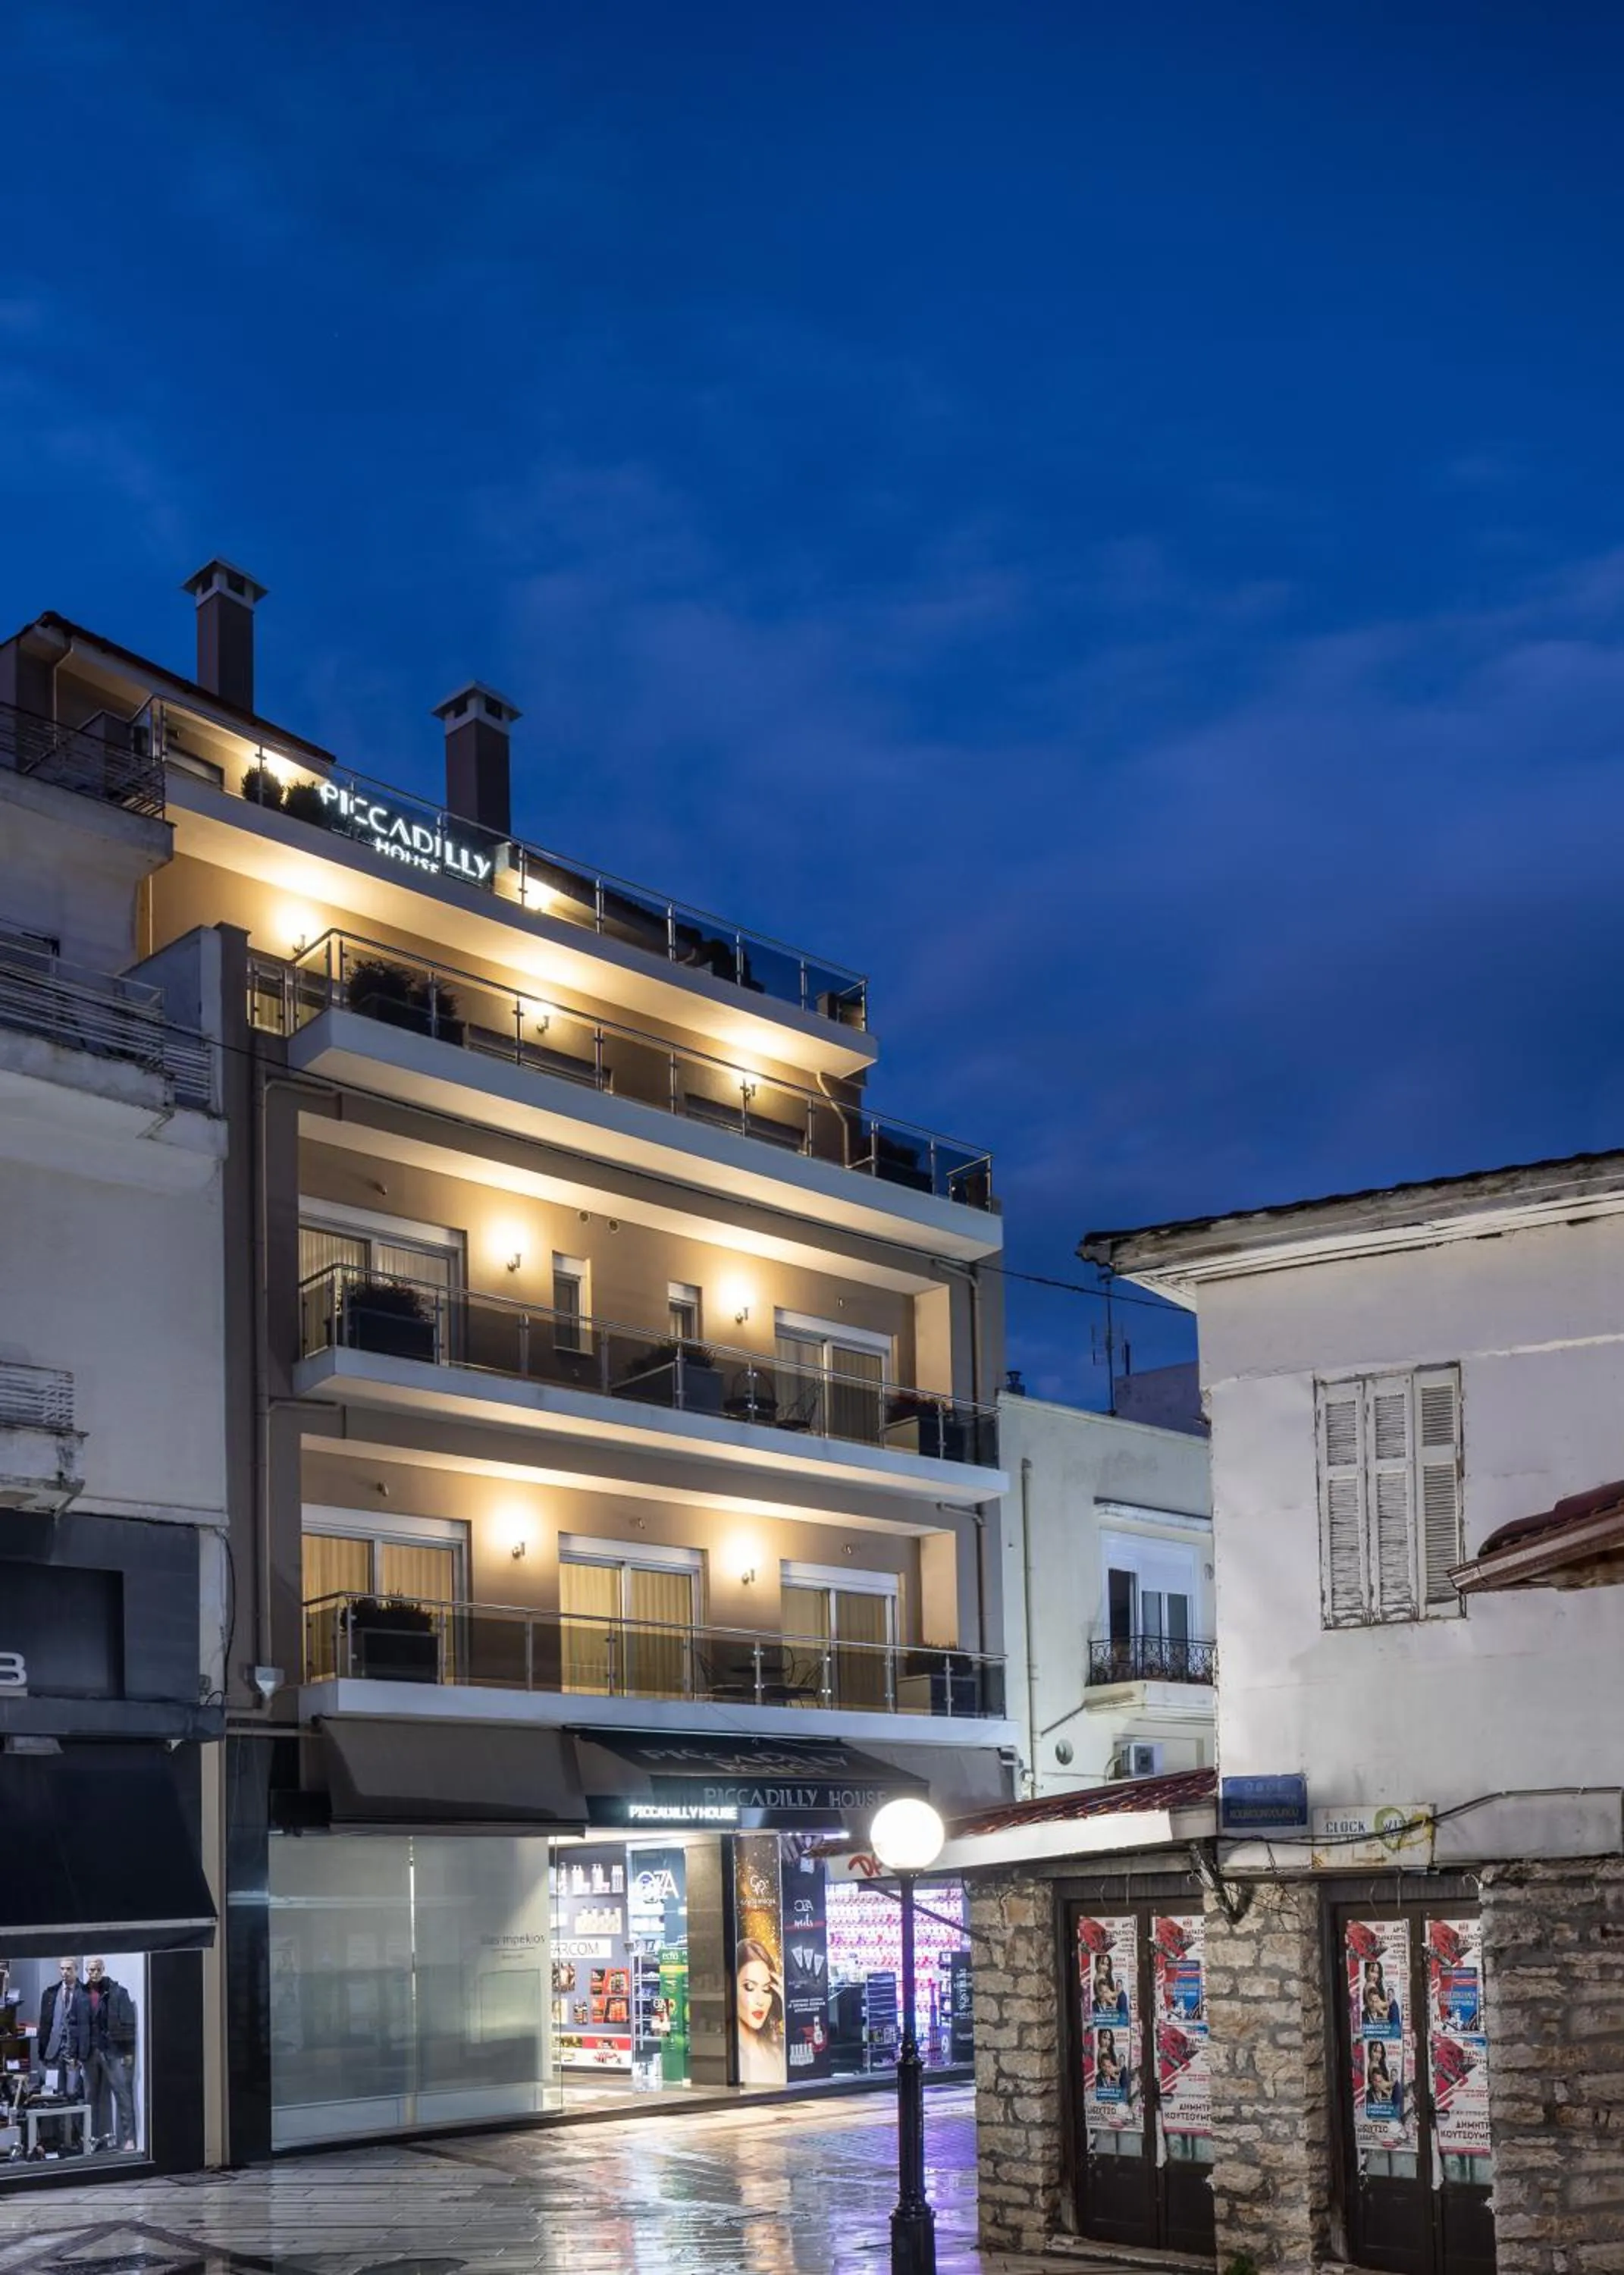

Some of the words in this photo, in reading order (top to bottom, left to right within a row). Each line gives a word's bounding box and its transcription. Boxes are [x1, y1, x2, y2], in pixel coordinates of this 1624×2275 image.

[320, 782, 491, 879] PICCADILLY
[704, 1787, 818, 1807] PICCADILLY
[629, 1806, 698, 1818] PICCADILLY
[698, 1806, 738, 1819] HOUSE
